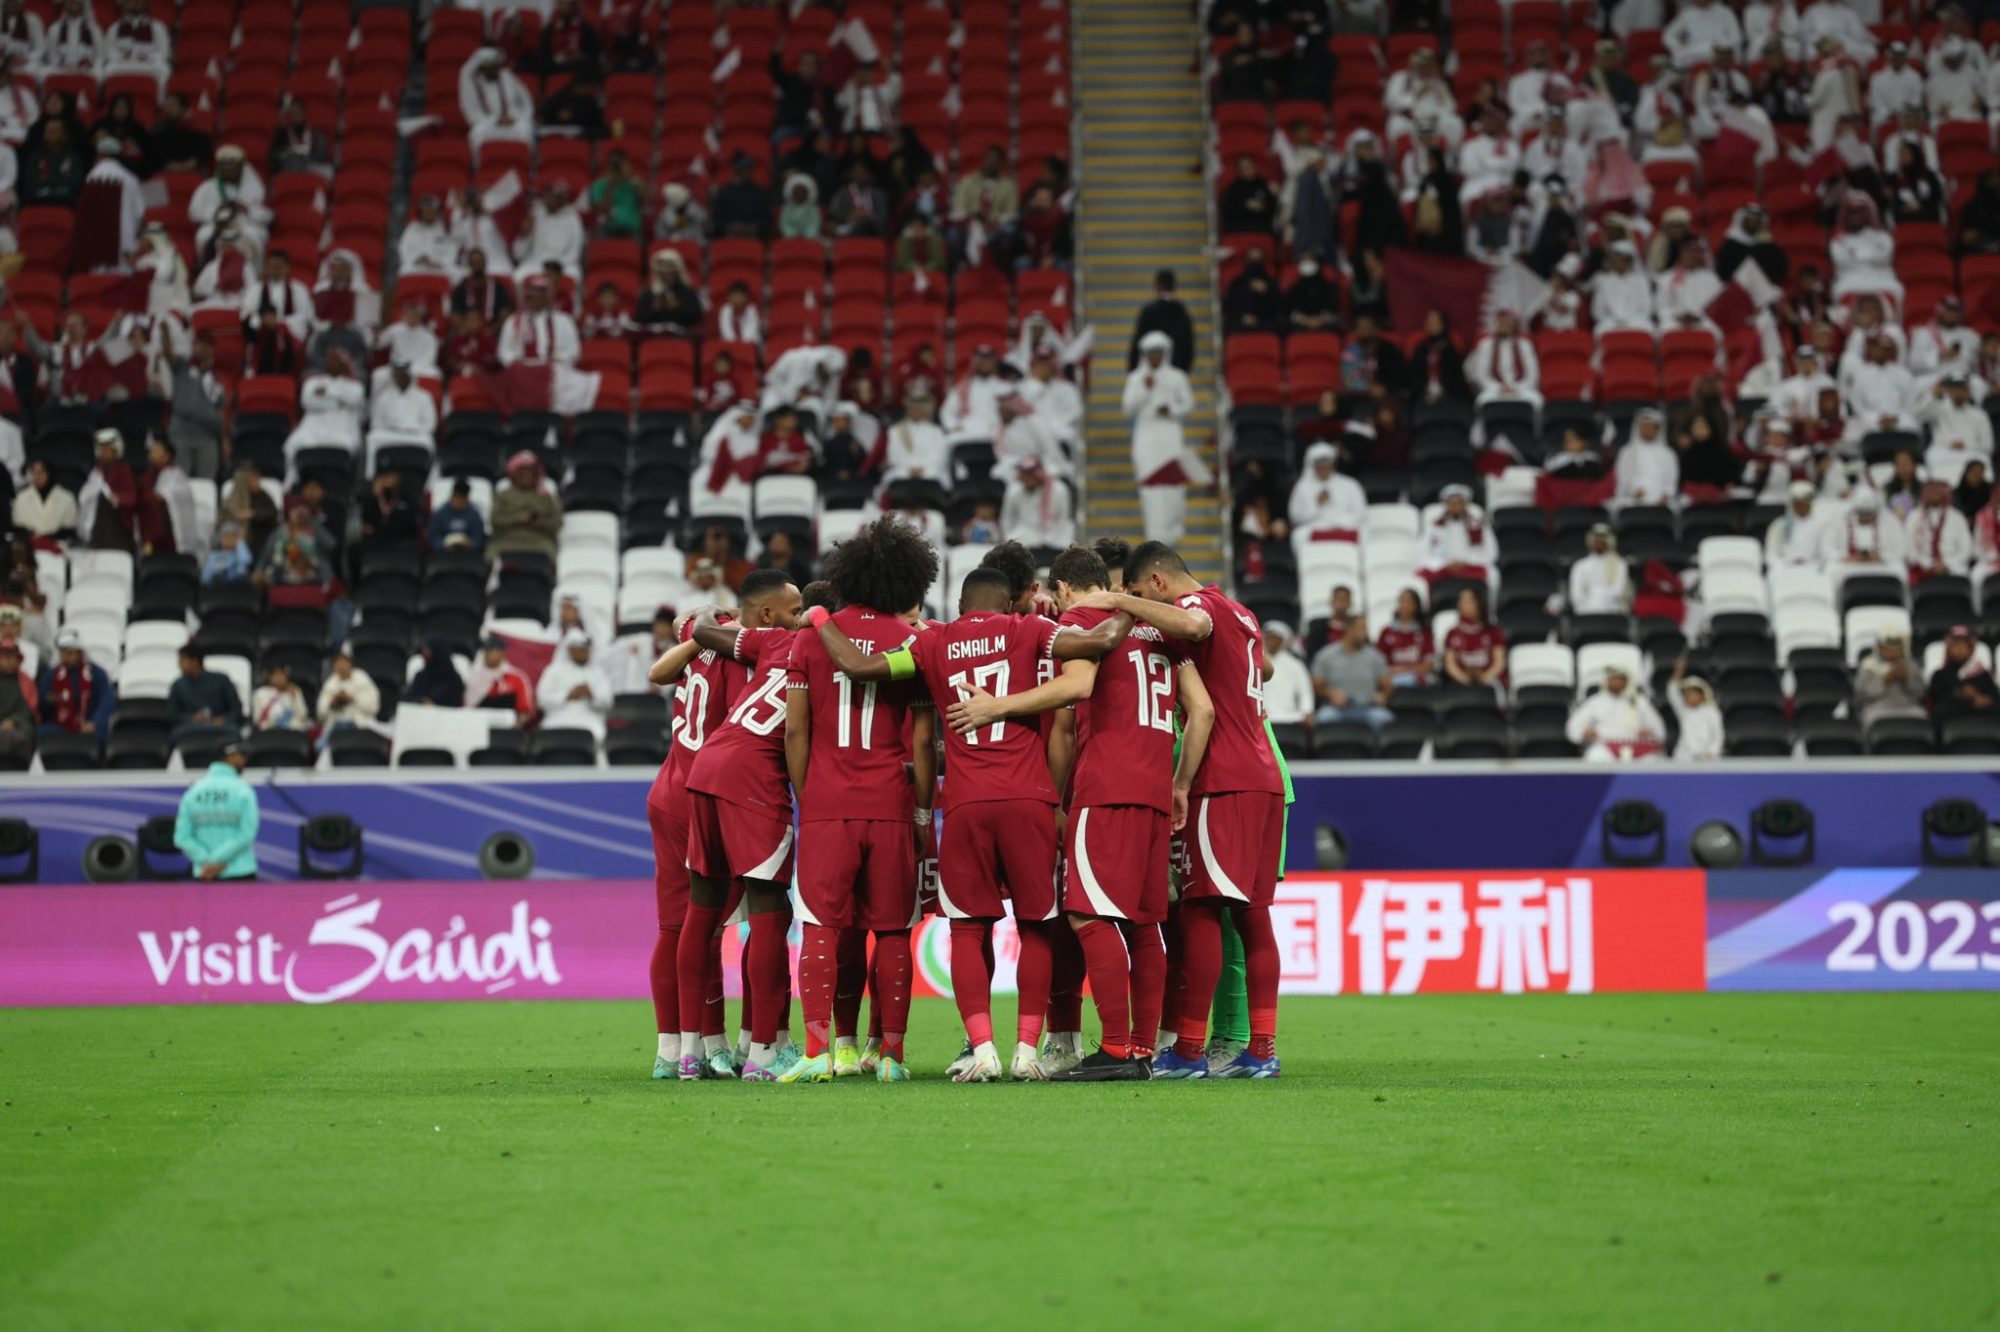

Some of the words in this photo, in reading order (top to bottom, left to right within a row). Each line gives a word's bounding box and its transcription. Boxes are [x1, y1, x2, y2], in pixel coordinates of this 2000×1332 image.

[947, 634, 1006, 660] ISMAIL.M
[1246, 637, 1263, 717] 4
[833, 670, 878, 751] 11
[948, 659, 1010, 745] 17
[1128, 649, 1173, 734] 12
[917, 858, 940, 892] 15
[137, 926, 284, 986] Visit
[283, 893, 563, 1005] Saudi
[1268, 880, 1593, 995] 国伊利
